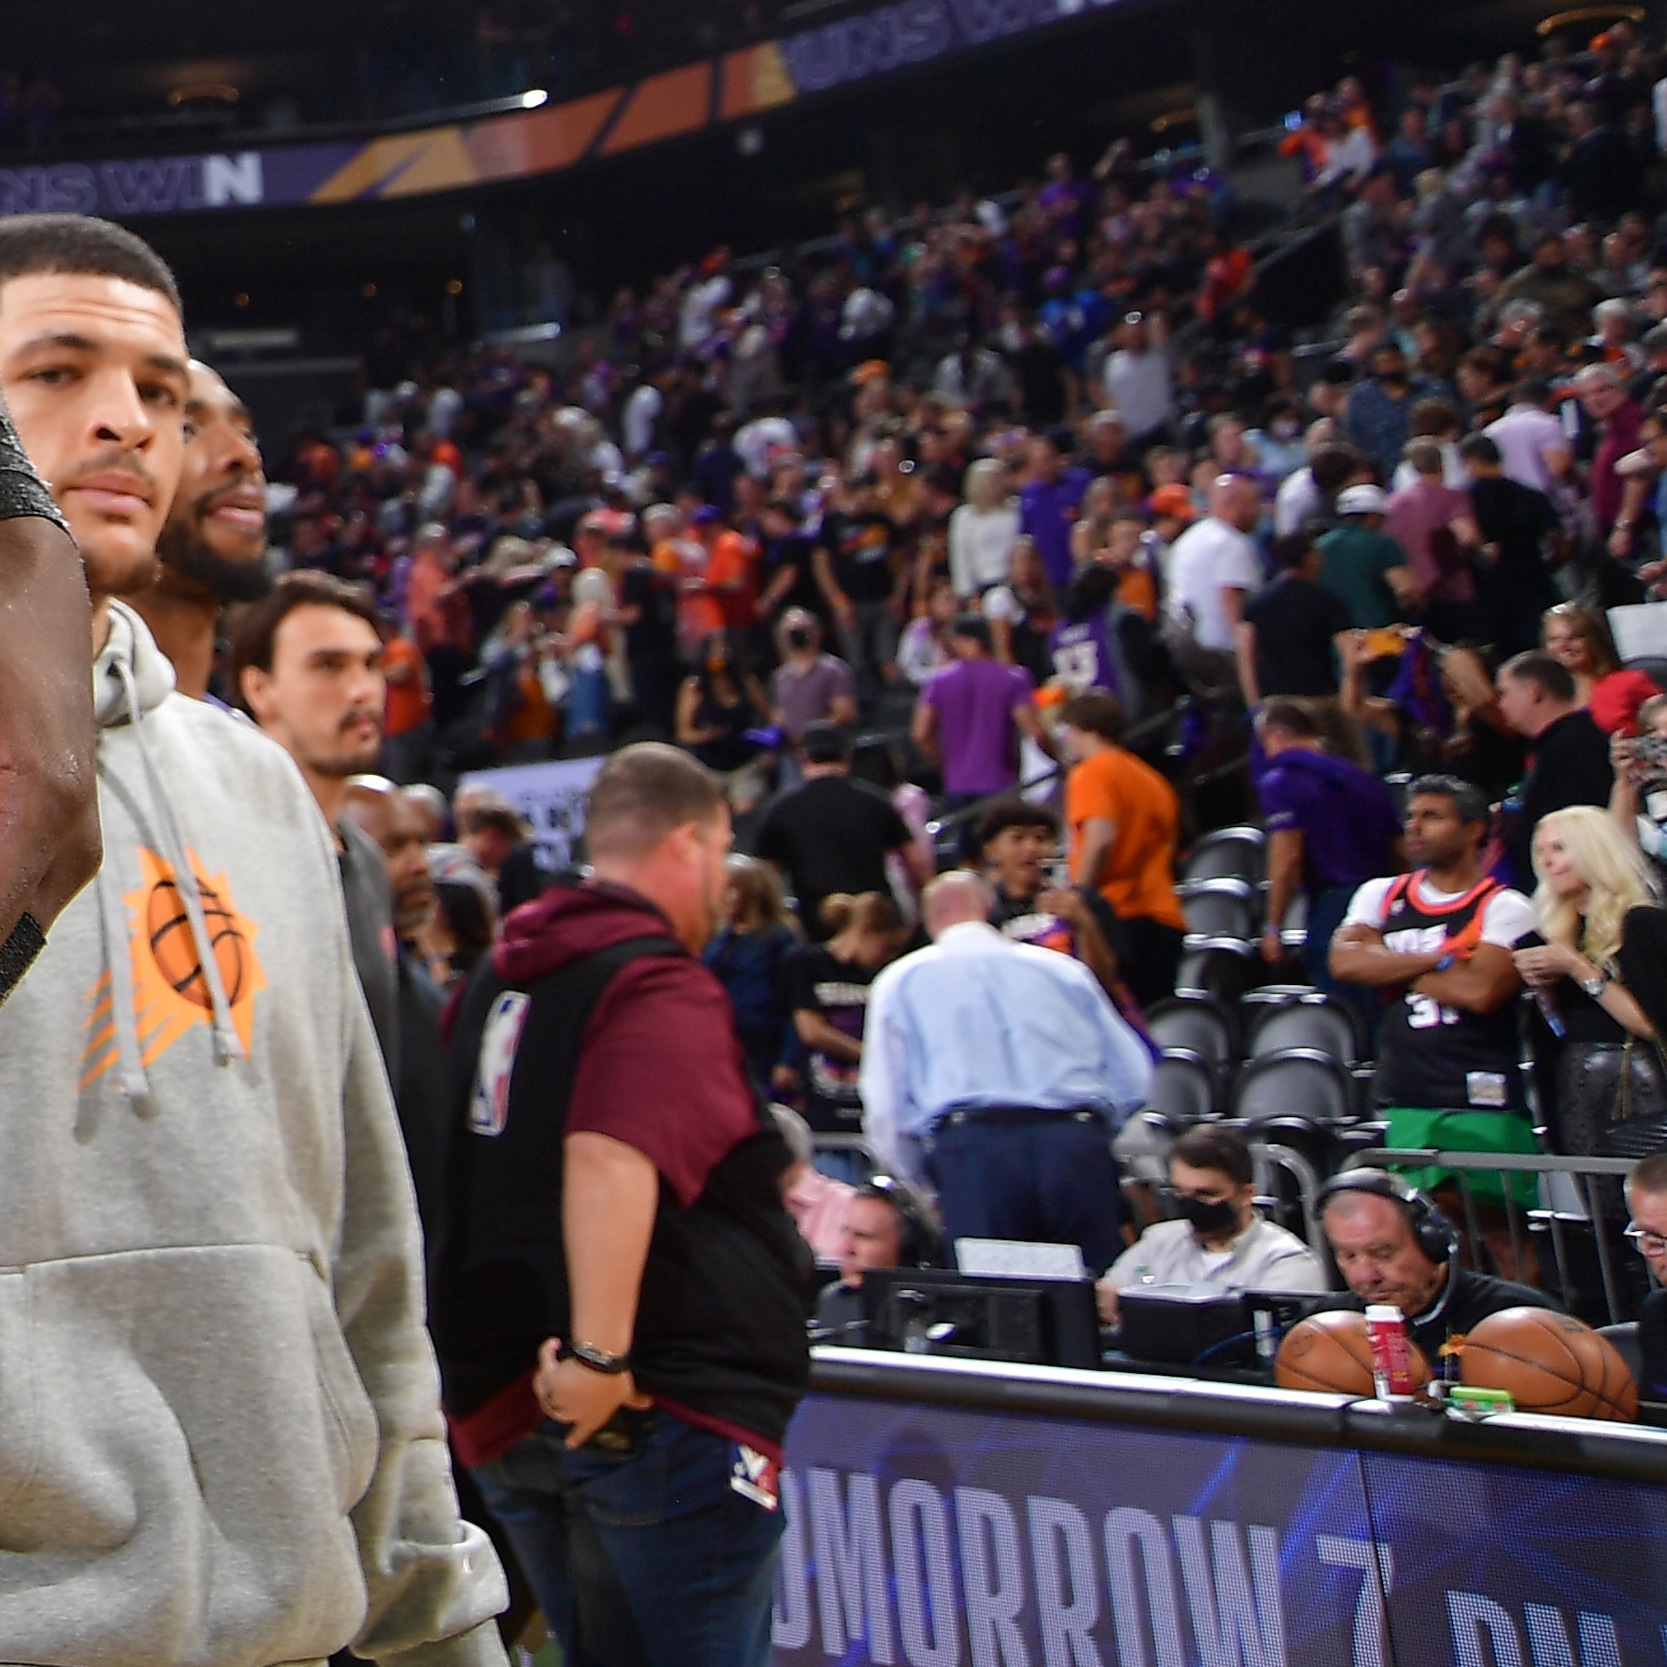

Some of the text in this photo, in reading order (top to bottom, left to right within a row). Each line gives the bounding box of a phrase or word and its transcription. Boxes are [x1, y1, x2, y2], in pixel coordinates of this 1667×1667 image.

[102, 150, 264, 214] WIN
[771, 1468, 1287, 1667] OMORROW
[1314, 1534, 1395, 1667] 7
